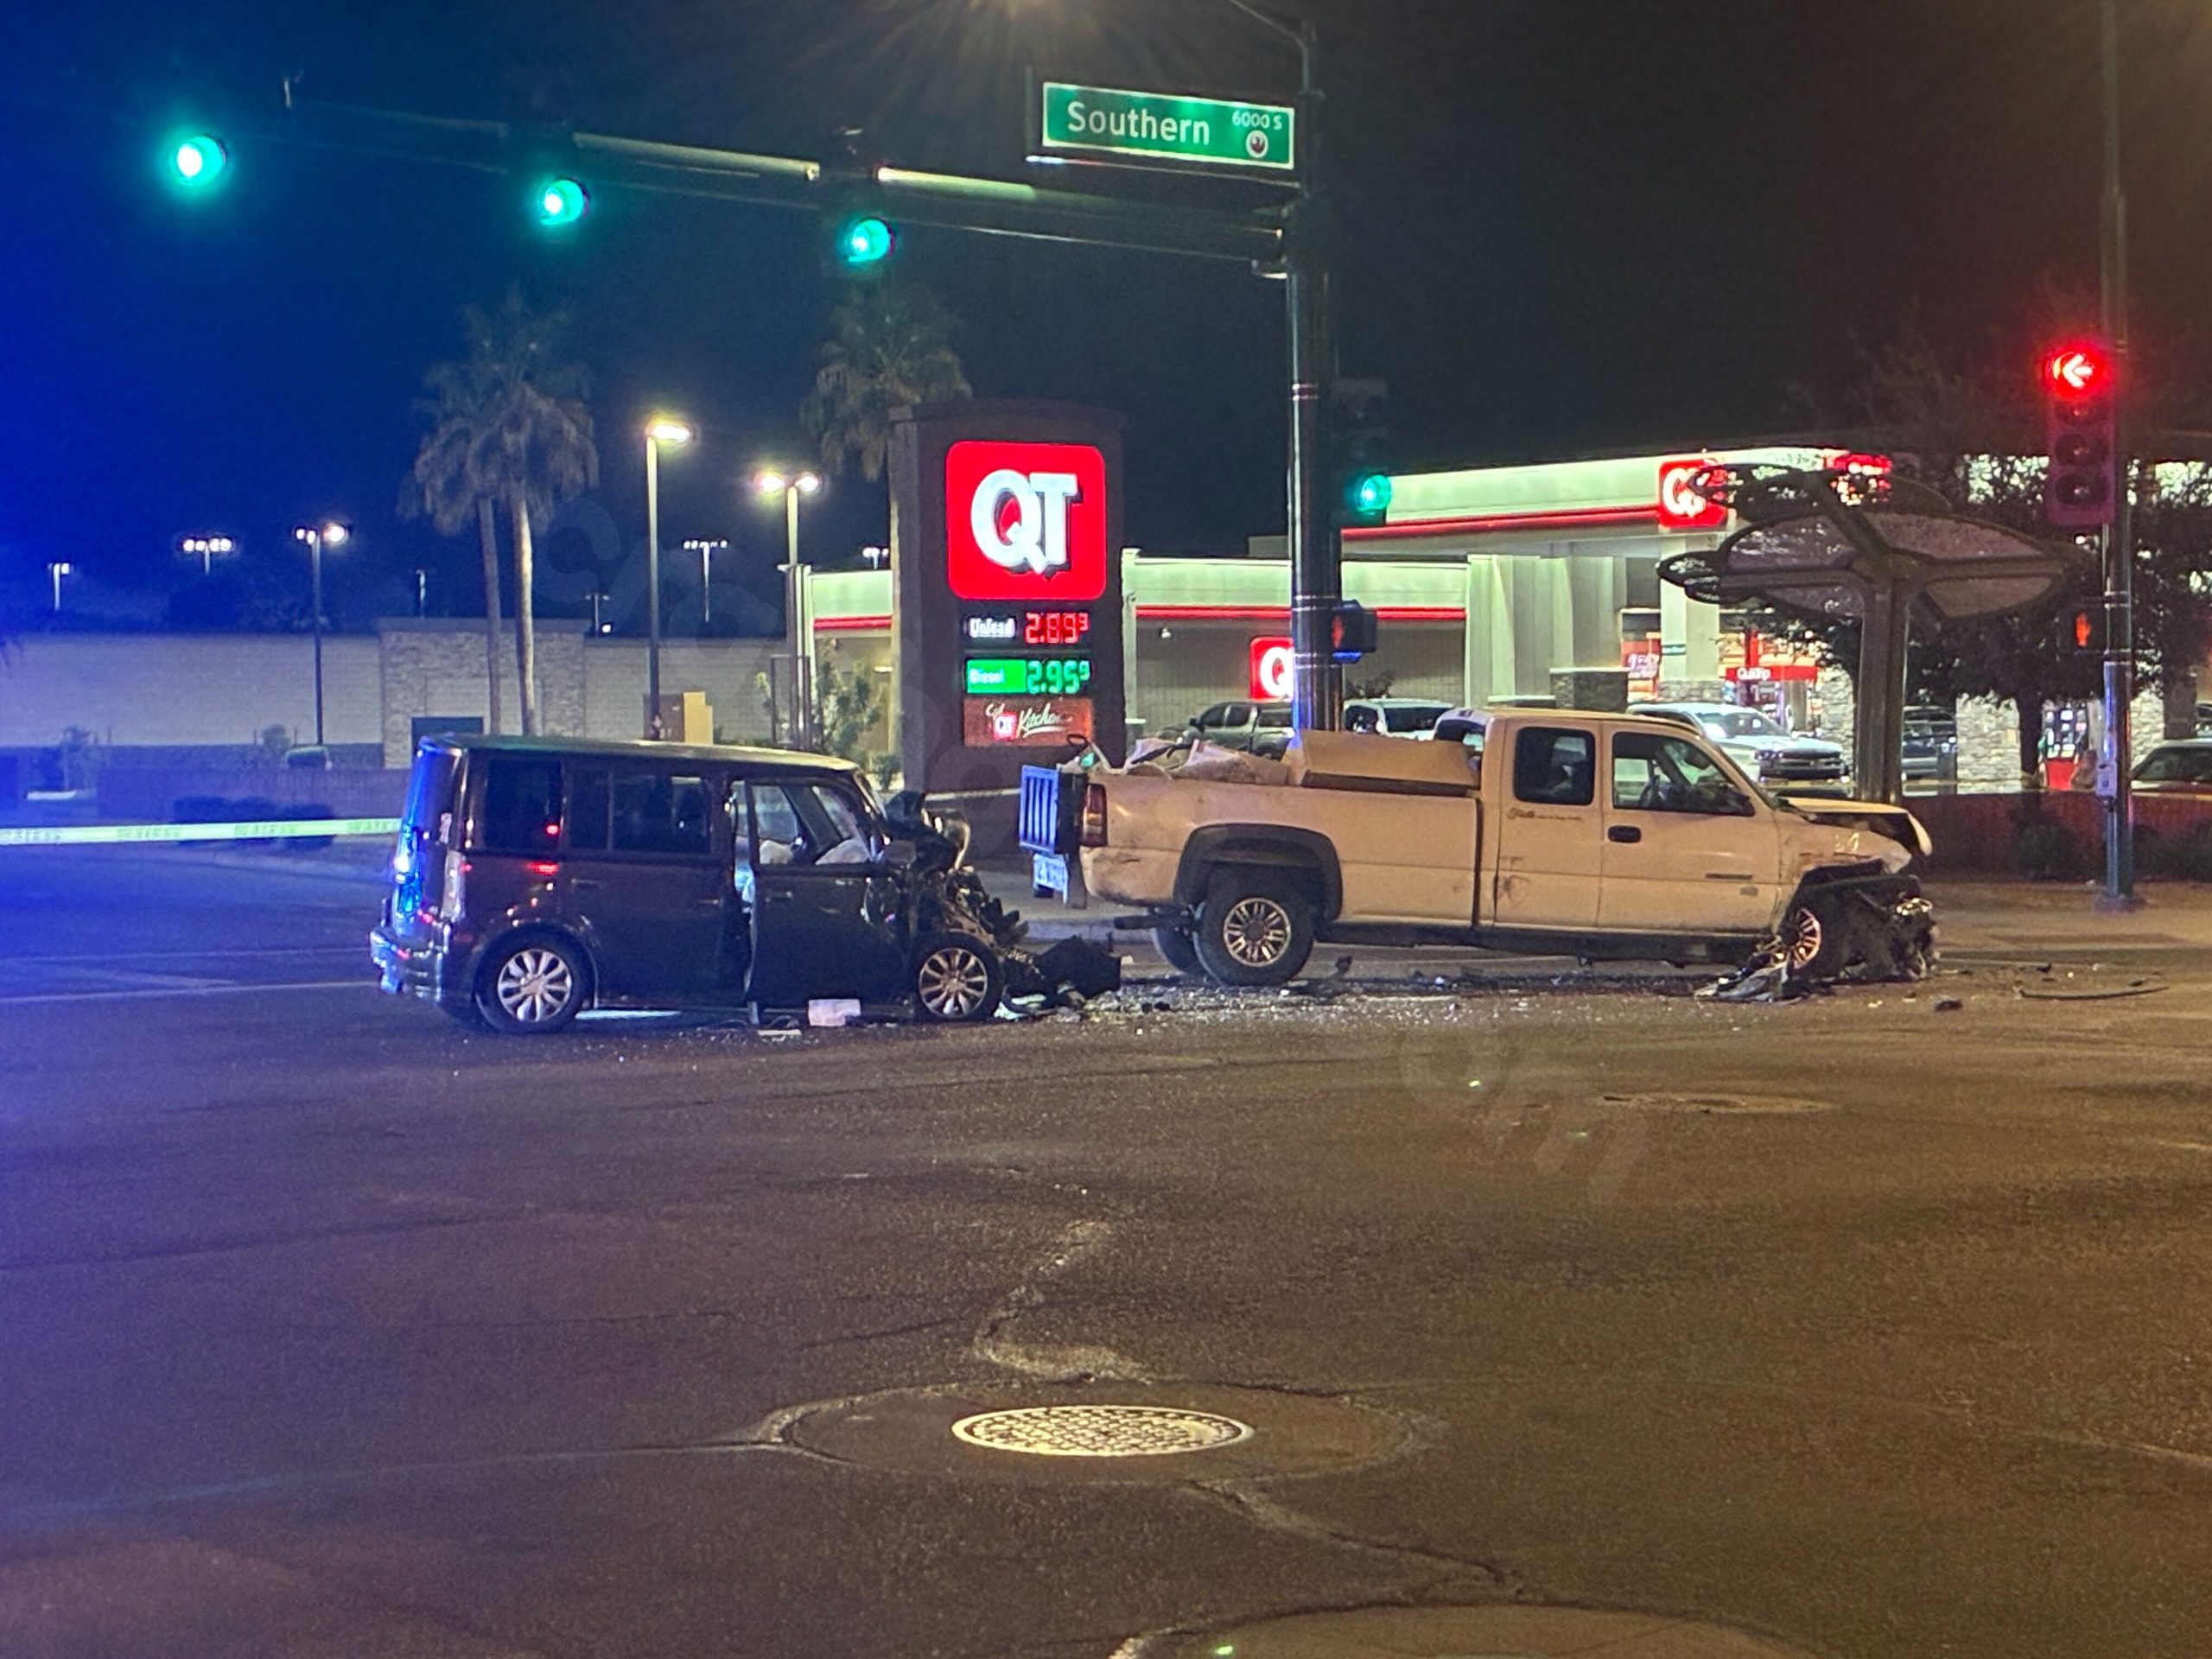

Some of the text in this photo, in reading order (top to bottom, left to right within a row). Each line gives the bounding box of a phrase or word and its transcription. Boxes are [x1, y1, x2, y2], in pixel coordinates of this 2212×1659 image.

[1067, 100, 1210, 145] Southern
[1231, 111, 1282, 130] 6000 S
[970, 468, 1079, 575] QT
[1027, 660, 1090, 695] 2.959
[1260, 645, 1294, 697] Q
